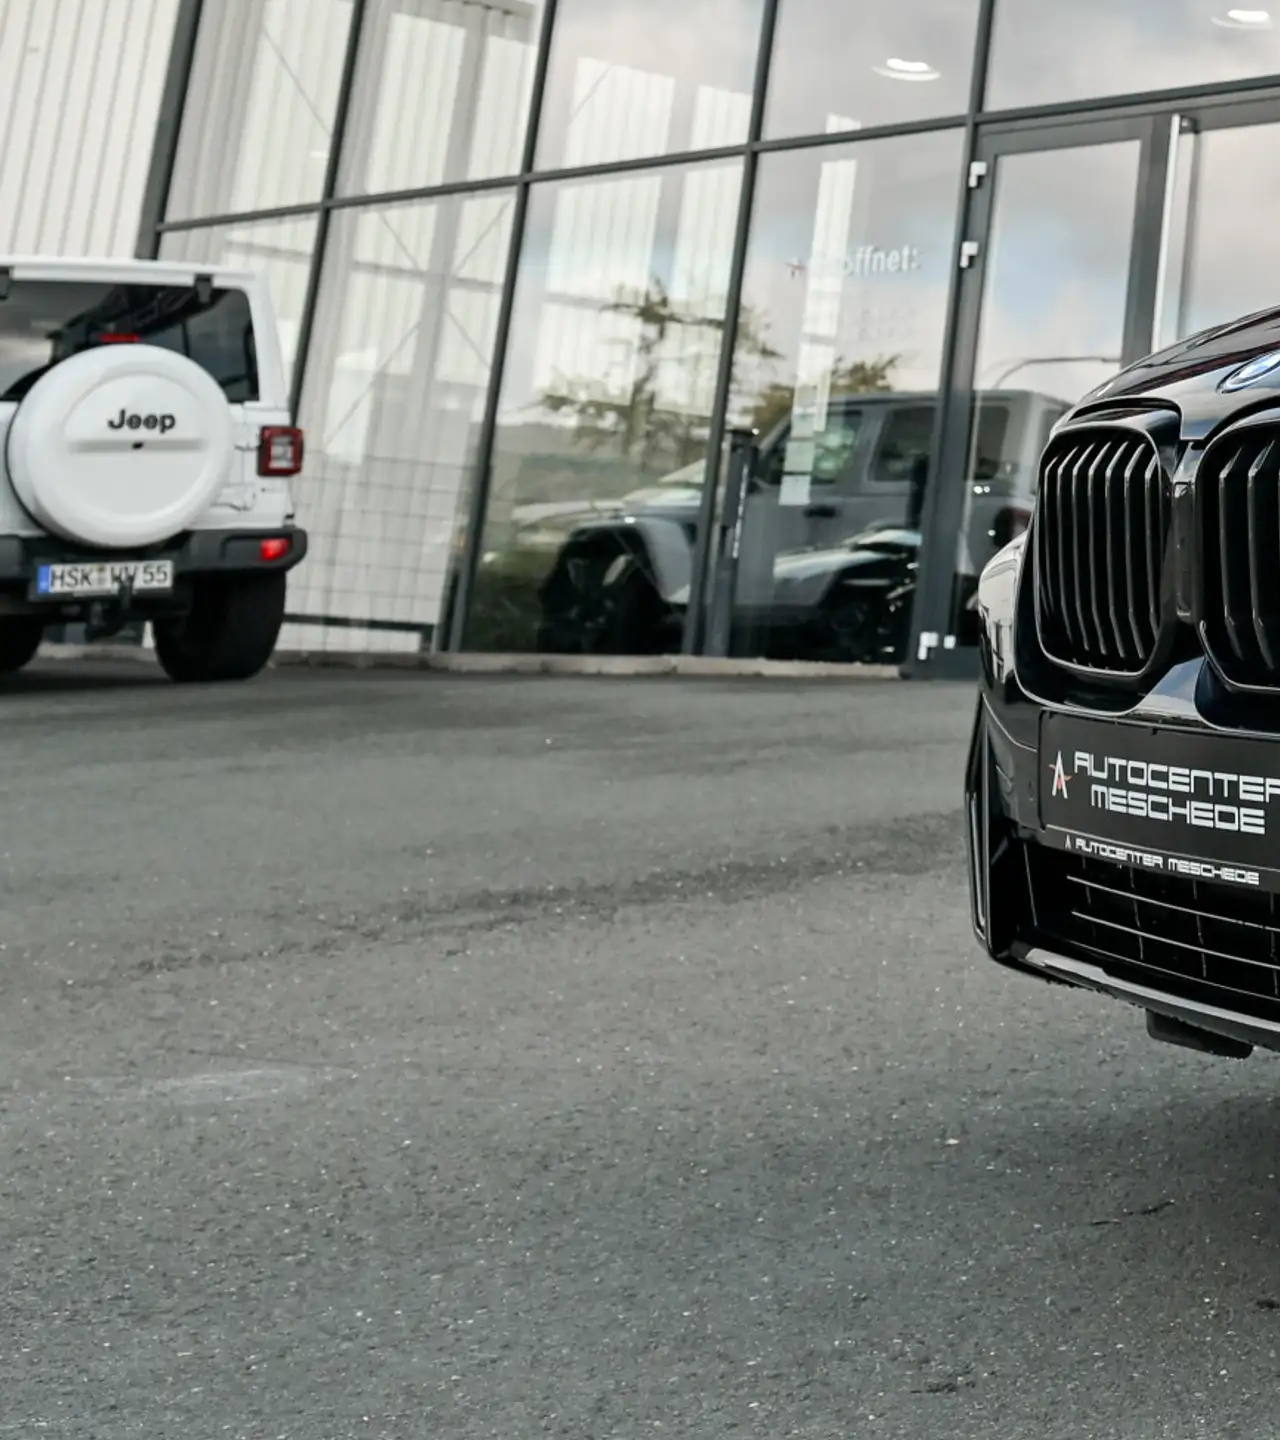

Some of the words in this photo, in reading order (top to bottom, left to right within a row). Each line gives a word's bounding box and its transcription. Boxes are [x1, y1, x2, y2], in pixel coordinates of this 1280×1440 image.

[108, 408, 176, 434] Jeep
[51, 567, 93, 588] HSK
[142, 563, 168, 584] 55
[1090, 783, 1266, 835] MESCHEDE
[1075, 837, 1164, 870] AUTOCENTER
[1167, 857, 1260, 886] MESCHEDE
